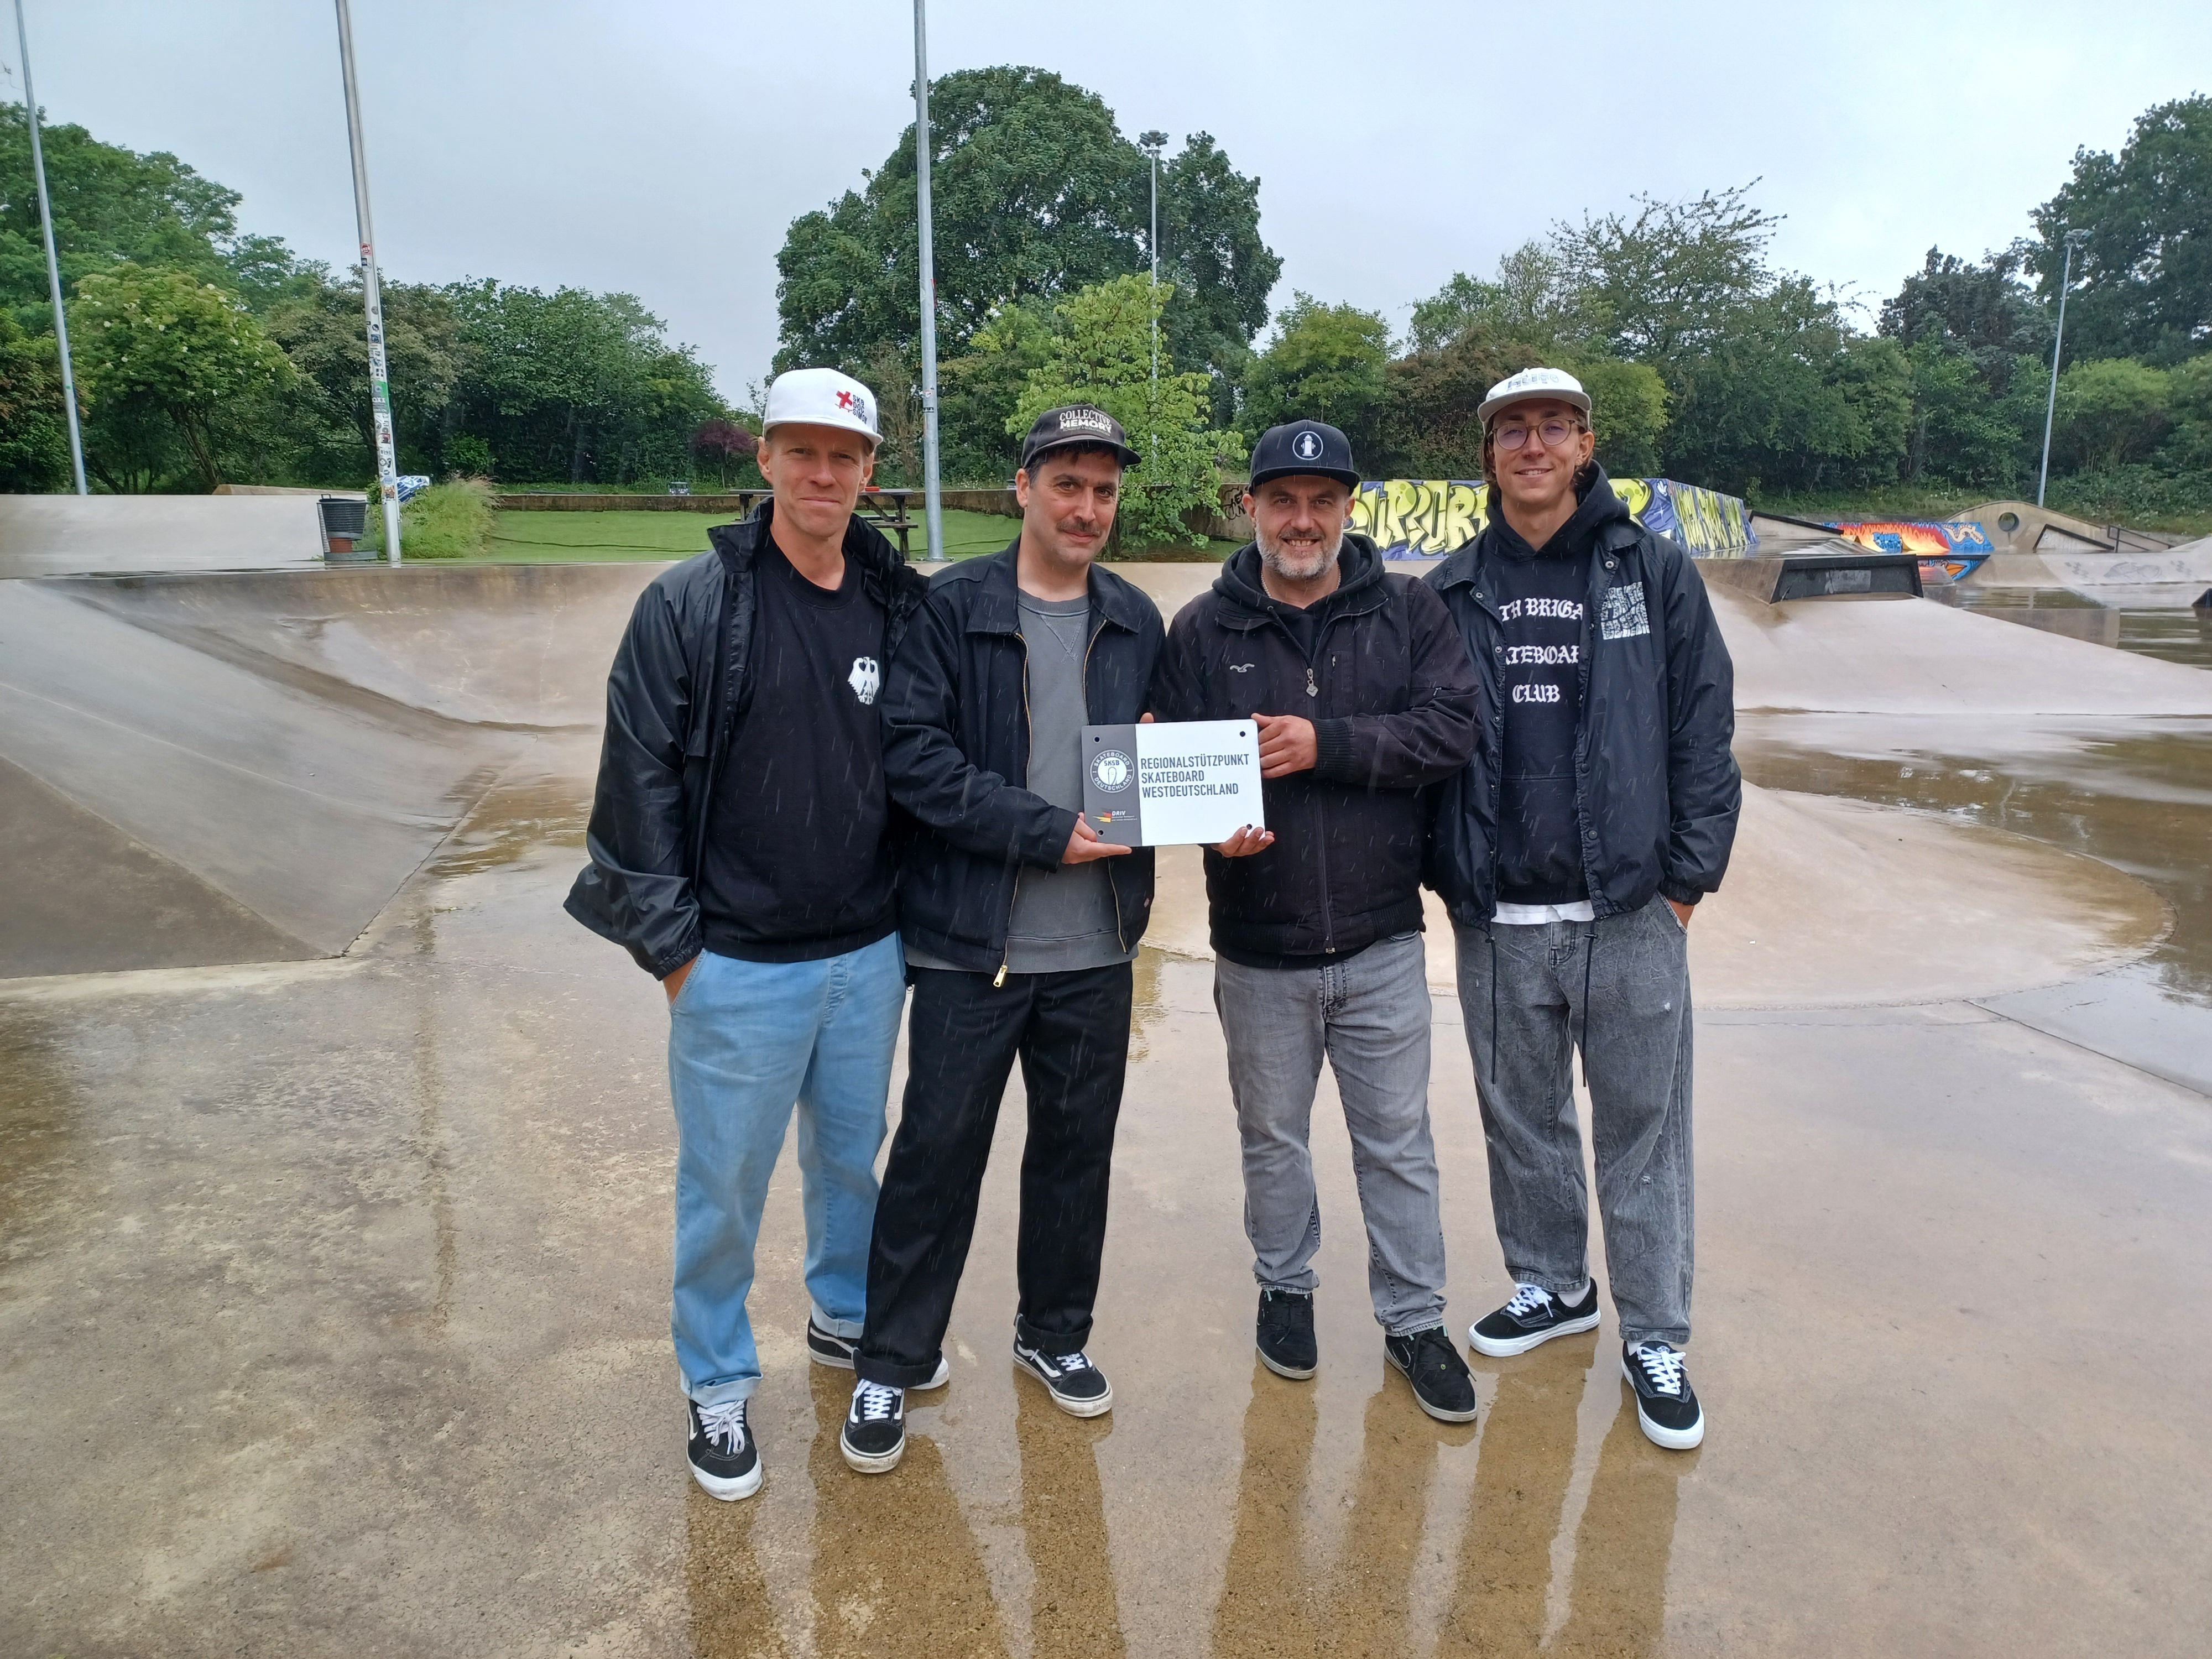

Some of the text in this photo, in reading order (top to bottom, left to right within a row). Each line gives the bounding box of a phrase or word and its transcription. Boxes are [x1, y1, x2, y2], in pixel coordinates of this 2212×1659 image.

[853, 394, 864, 406] SKB
[853, 401, 864, 414] DOC
[853, 408, 868, 425] SIMON
[1060, 409, 1112, 426] COLLECTIVE
[1060, 419, 1112, 434] MEMORY
[1512, 684, 1561, 703] CLUB
[1094, 752, 1130, 767] SKATEBOARD
[1141, 753, 1250, 770] REGIONALSTÜTZPUNKT
[1094, 774, 1132, 791] DEUTSCHLAND
[1141, 770, 1205, 784] SKATEBOARD
[1142, 782, 1240, 799] WESTDEUTSCHLAND
